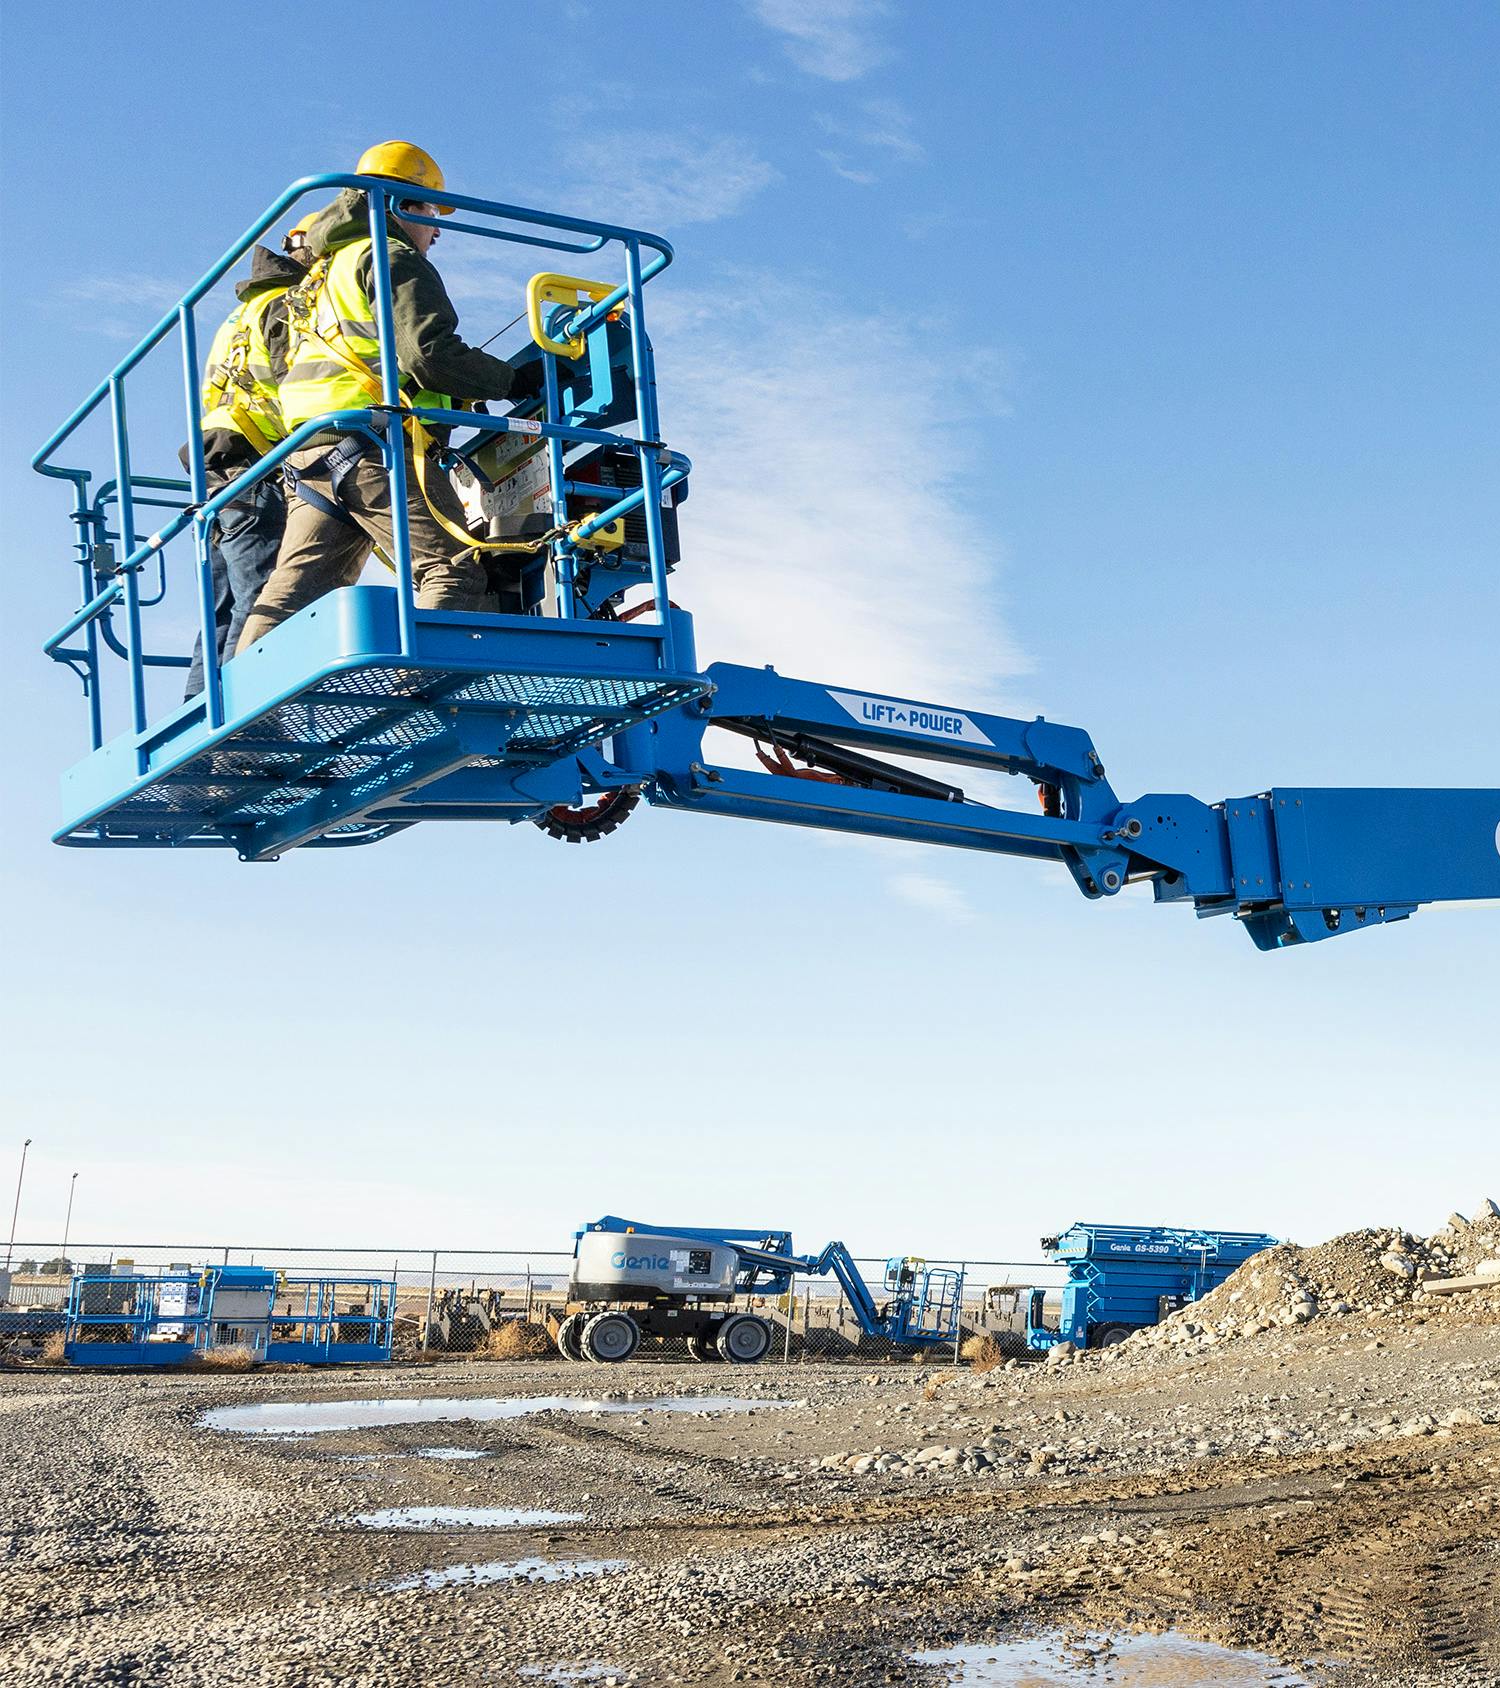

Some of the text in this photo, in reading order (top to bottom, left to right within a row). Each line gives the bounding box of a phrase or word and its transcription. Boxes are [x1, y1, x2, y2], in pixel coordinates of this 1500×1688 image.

[863, 702, 963, 735] LIFT POWER
[1110, 1243, 1169, 1253] Genie GS-5390
[611, 1252, 669, 1270] Genie
